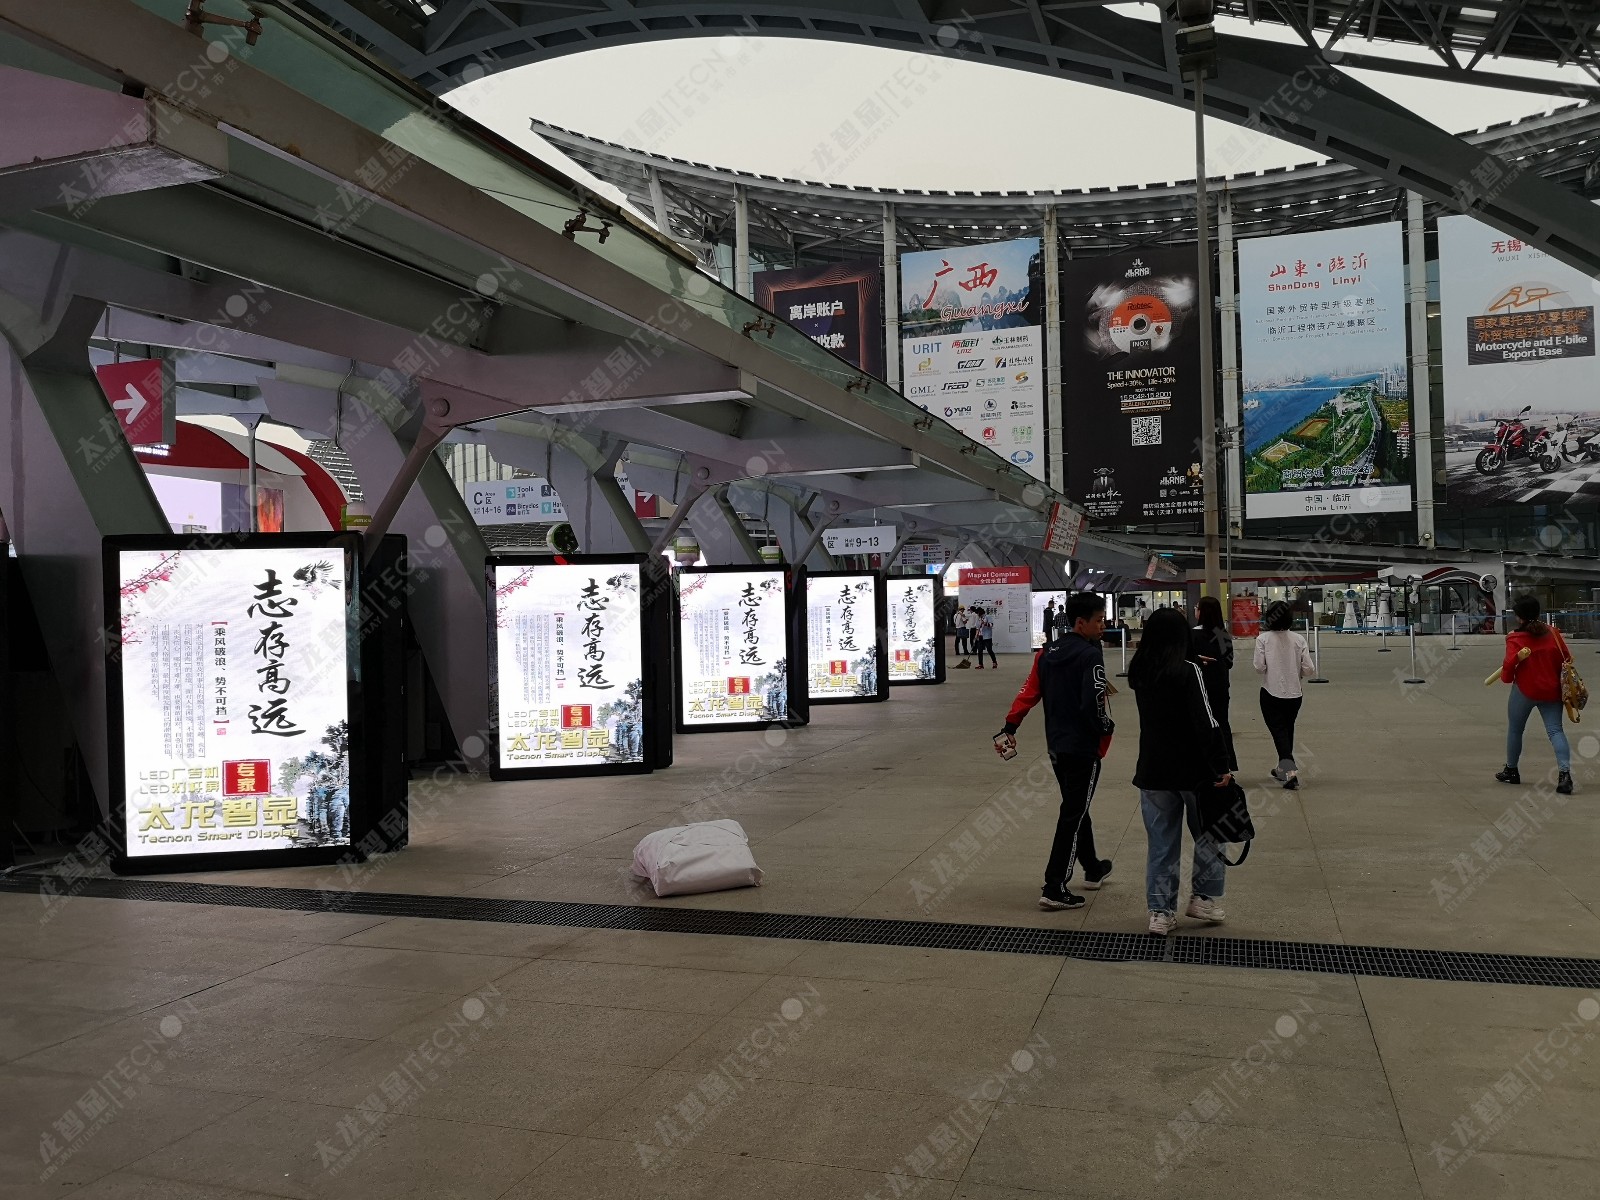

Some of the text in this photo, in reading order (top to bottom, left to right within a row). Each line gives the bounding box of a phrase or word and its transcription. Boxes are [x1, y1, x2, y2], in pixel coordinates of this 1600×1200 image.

[1497, 254, 1520, 262] WUXI
[922, 258, 998, 309] 广西
[1268, 275, 1361, 292] ShanDong Linyi
[789, 300, 843, 320] 离岸账户
[940, 299, 1029, 321] Guangxi
[1266, 297, 1375, 316] 国家外贸转型升级基地
[1267, 317, 1376, 336] 临沂工程物资产业集聚区
[1474, 309, 1588, 329] 国家摩托车及零部件
[1478, 323, 1580, 342] 外贸转型升级基地
[912, 342, 942, 355] URIT
[1475, 335, 1588, 352] Motorcycle and E-bike
[1502, 347, 1563, 360] Export Base
[1106, 366, 1176, 380] THE INNOVATOR
[910, 385, 935, 395] GML
[473, 492, 483, 505] C
[481, 506, 502, 514] 14-16
[827, 541, 835, 549] 区
[856, 536, 880, 547] 9-13
[738, 582, 766, 665] 志存高远
[838, 584, 860, 651] 志存高远
[902, 586, 921, 642] 志存高远
[577, 578, 615, 690] 志存高远
[247, 569, 306, 737] 志存高远
[506, 729, 610, 752] 太龙智显
[138, 797, 298, 831] 太龙智显
[138, 829, 301, 843] Tecnon Smart Display
